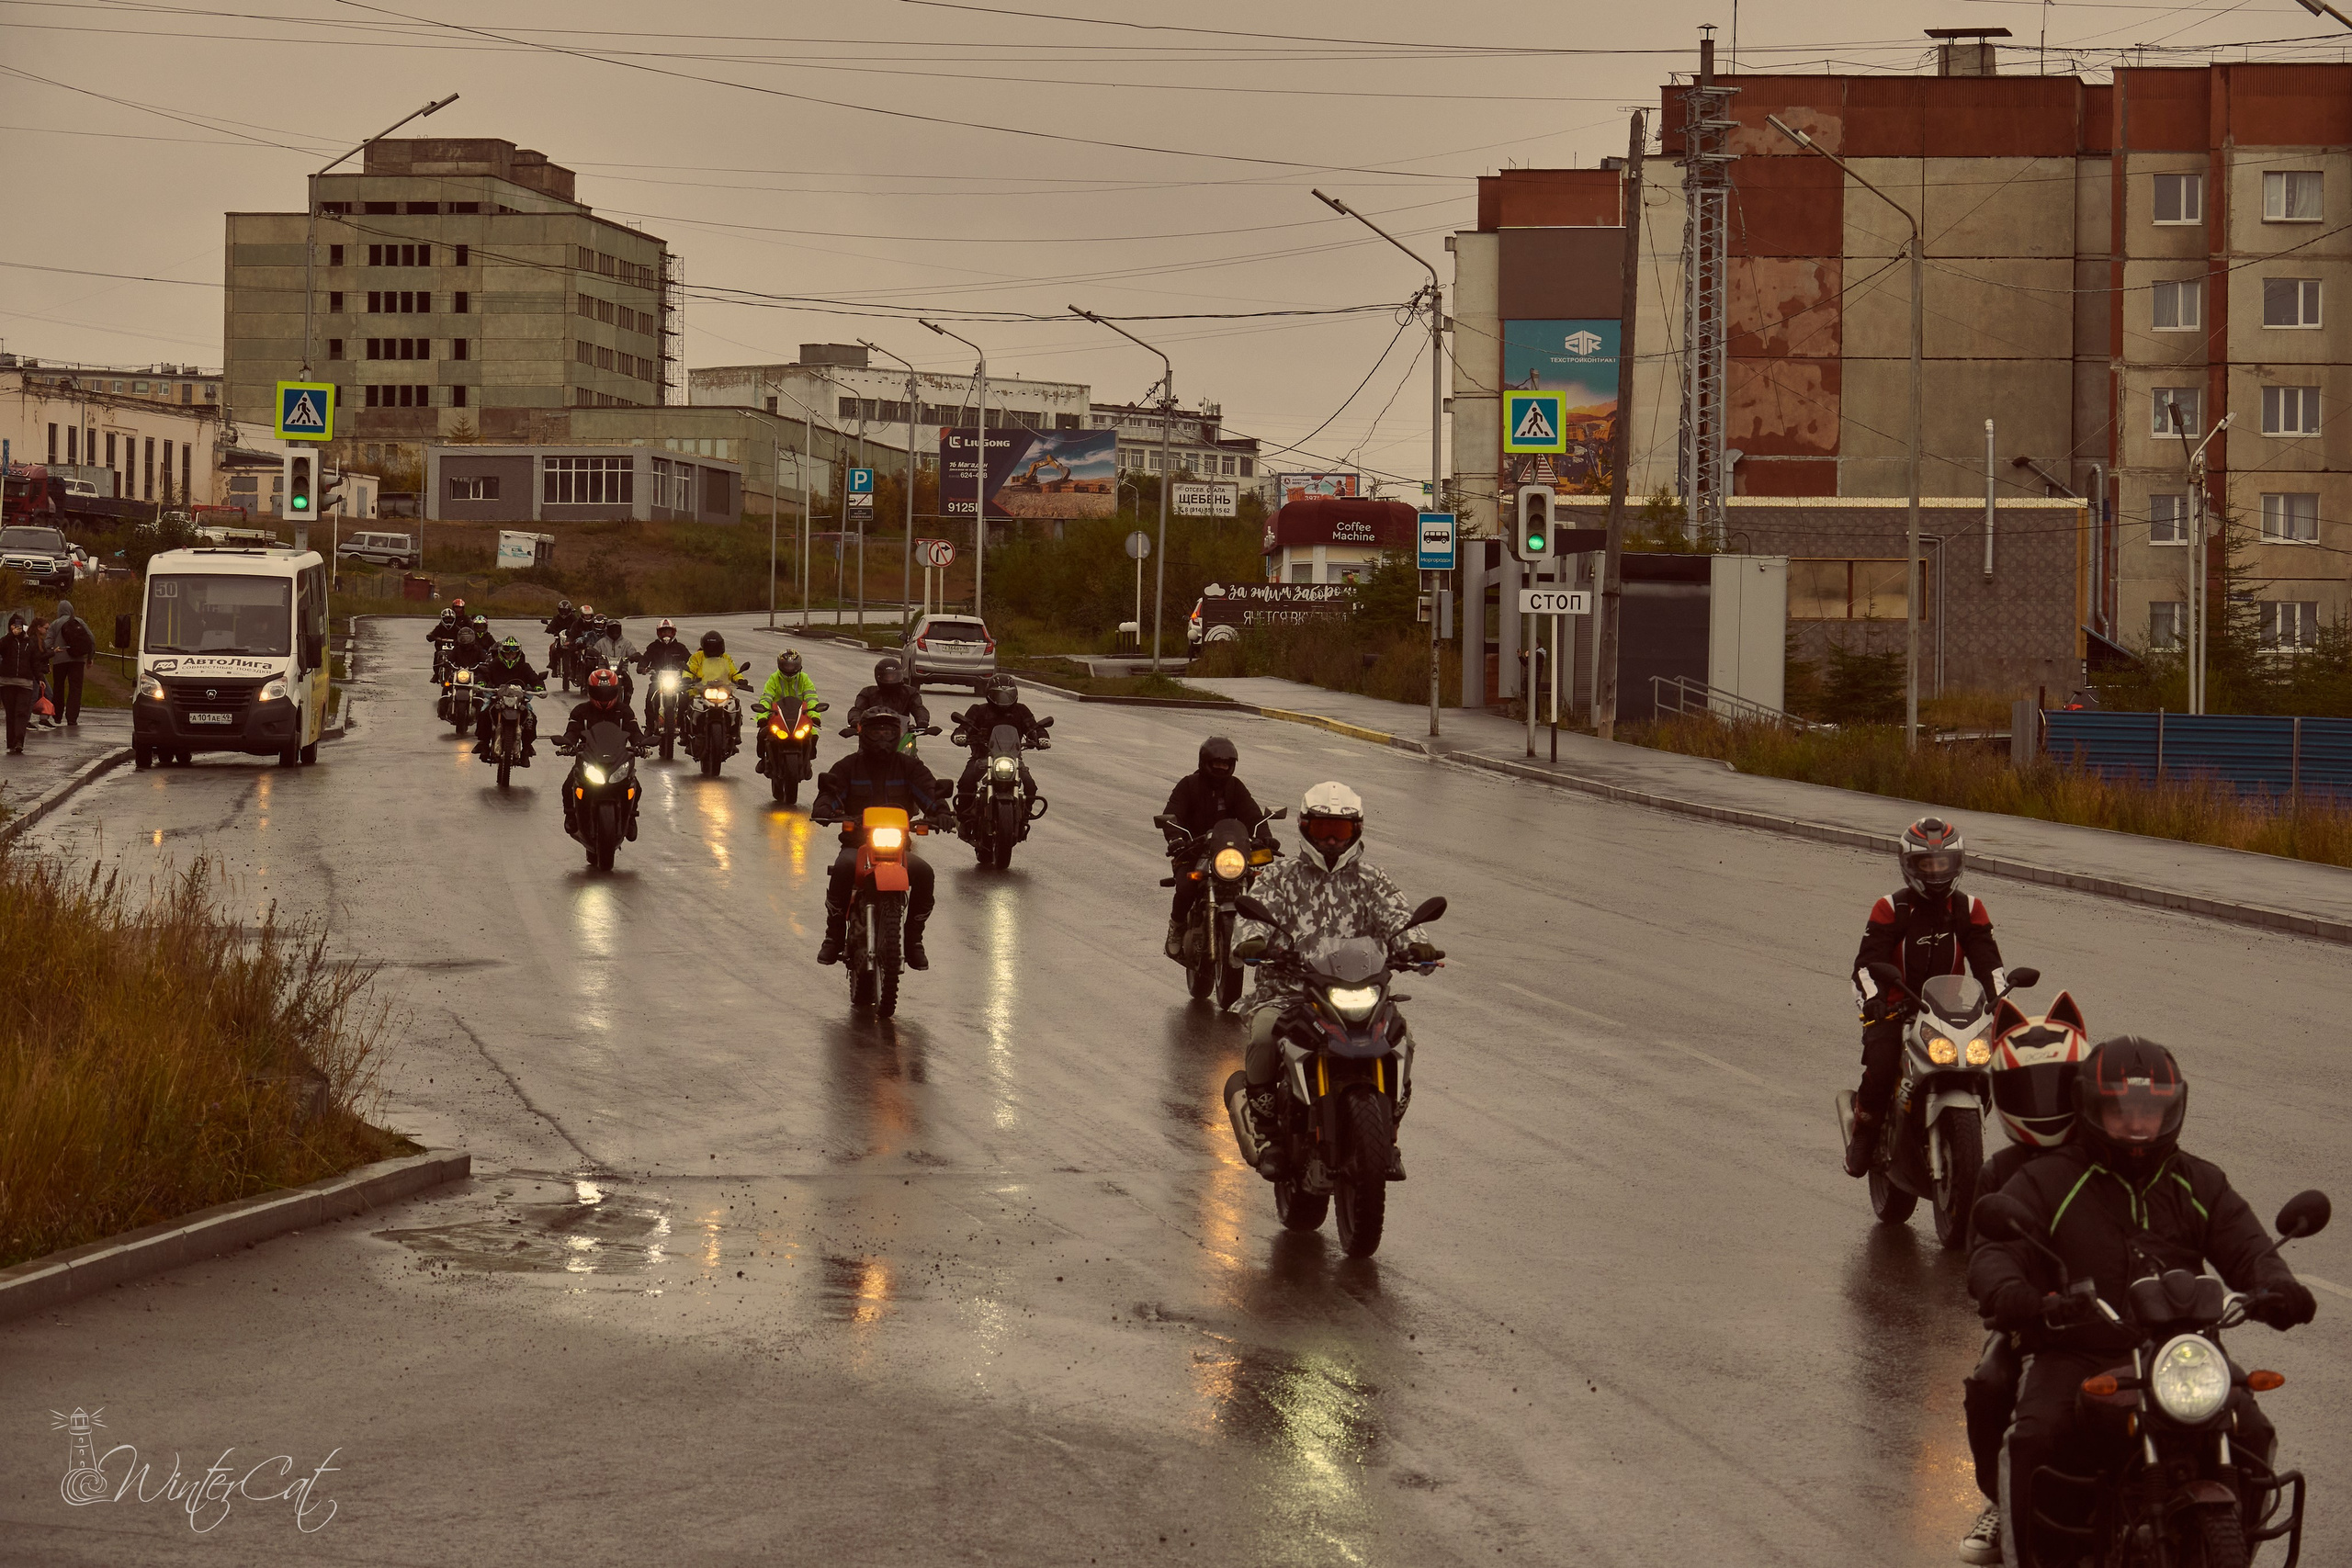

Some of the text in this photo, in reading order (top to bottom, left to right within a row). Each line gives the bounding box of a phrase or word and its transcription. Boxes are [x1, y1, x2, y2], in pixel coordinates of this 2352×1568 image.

[854, 470, 868, 491] P
[1179, 494, 1231, 505] ЩЕБЕНЬ
[1336, 521, 1372, 532] Coffee
[1332, 531, 1375, 542] Machine
[155, 582, 176, 597] 50
[1228, 584, 1248, 601] за
[1530, 593, 1581, 611] СТОП
[183, 658, 272, 670] АвтоЛига
